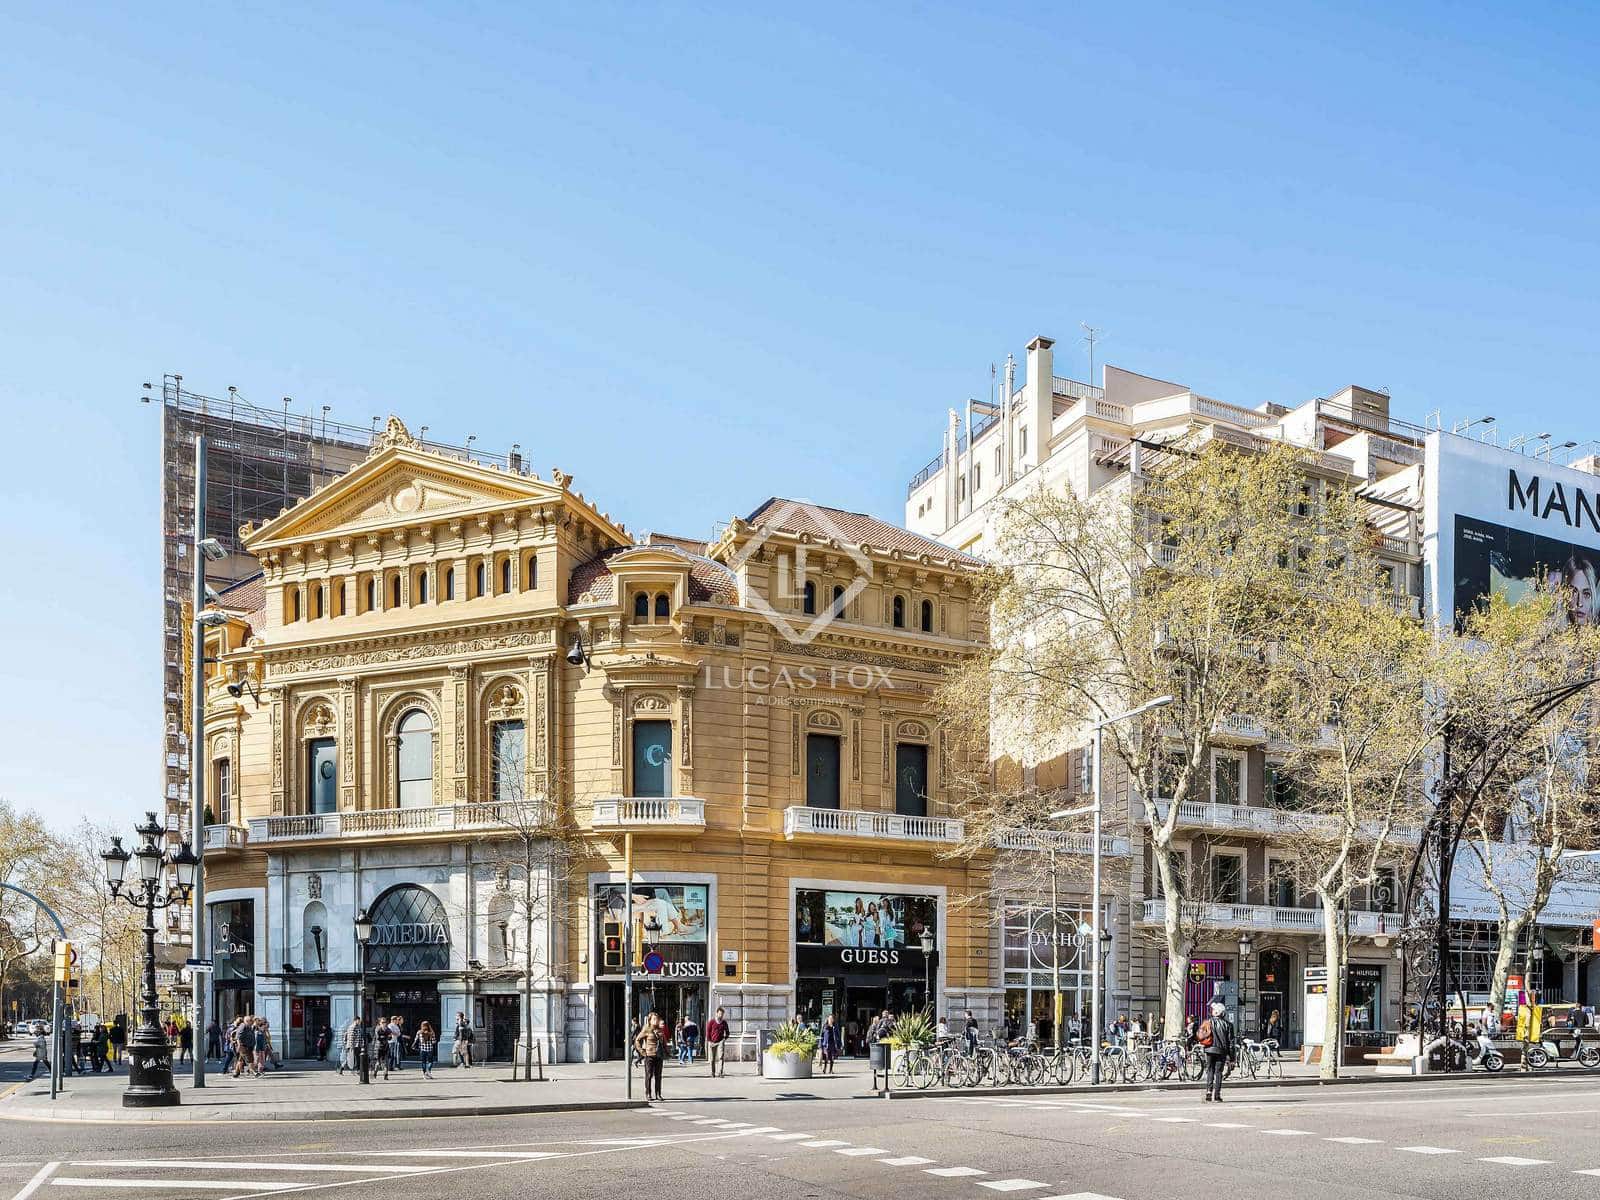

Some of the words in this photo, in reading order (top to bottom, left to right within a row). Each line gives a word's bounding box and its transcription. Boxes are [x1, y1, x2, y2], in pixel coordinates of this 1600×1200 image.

[367, 923, 448, 945] OMEDIA
[841, 949, 899, 964] GUESS
[631, 961, 705, 976] LOTUSSE
